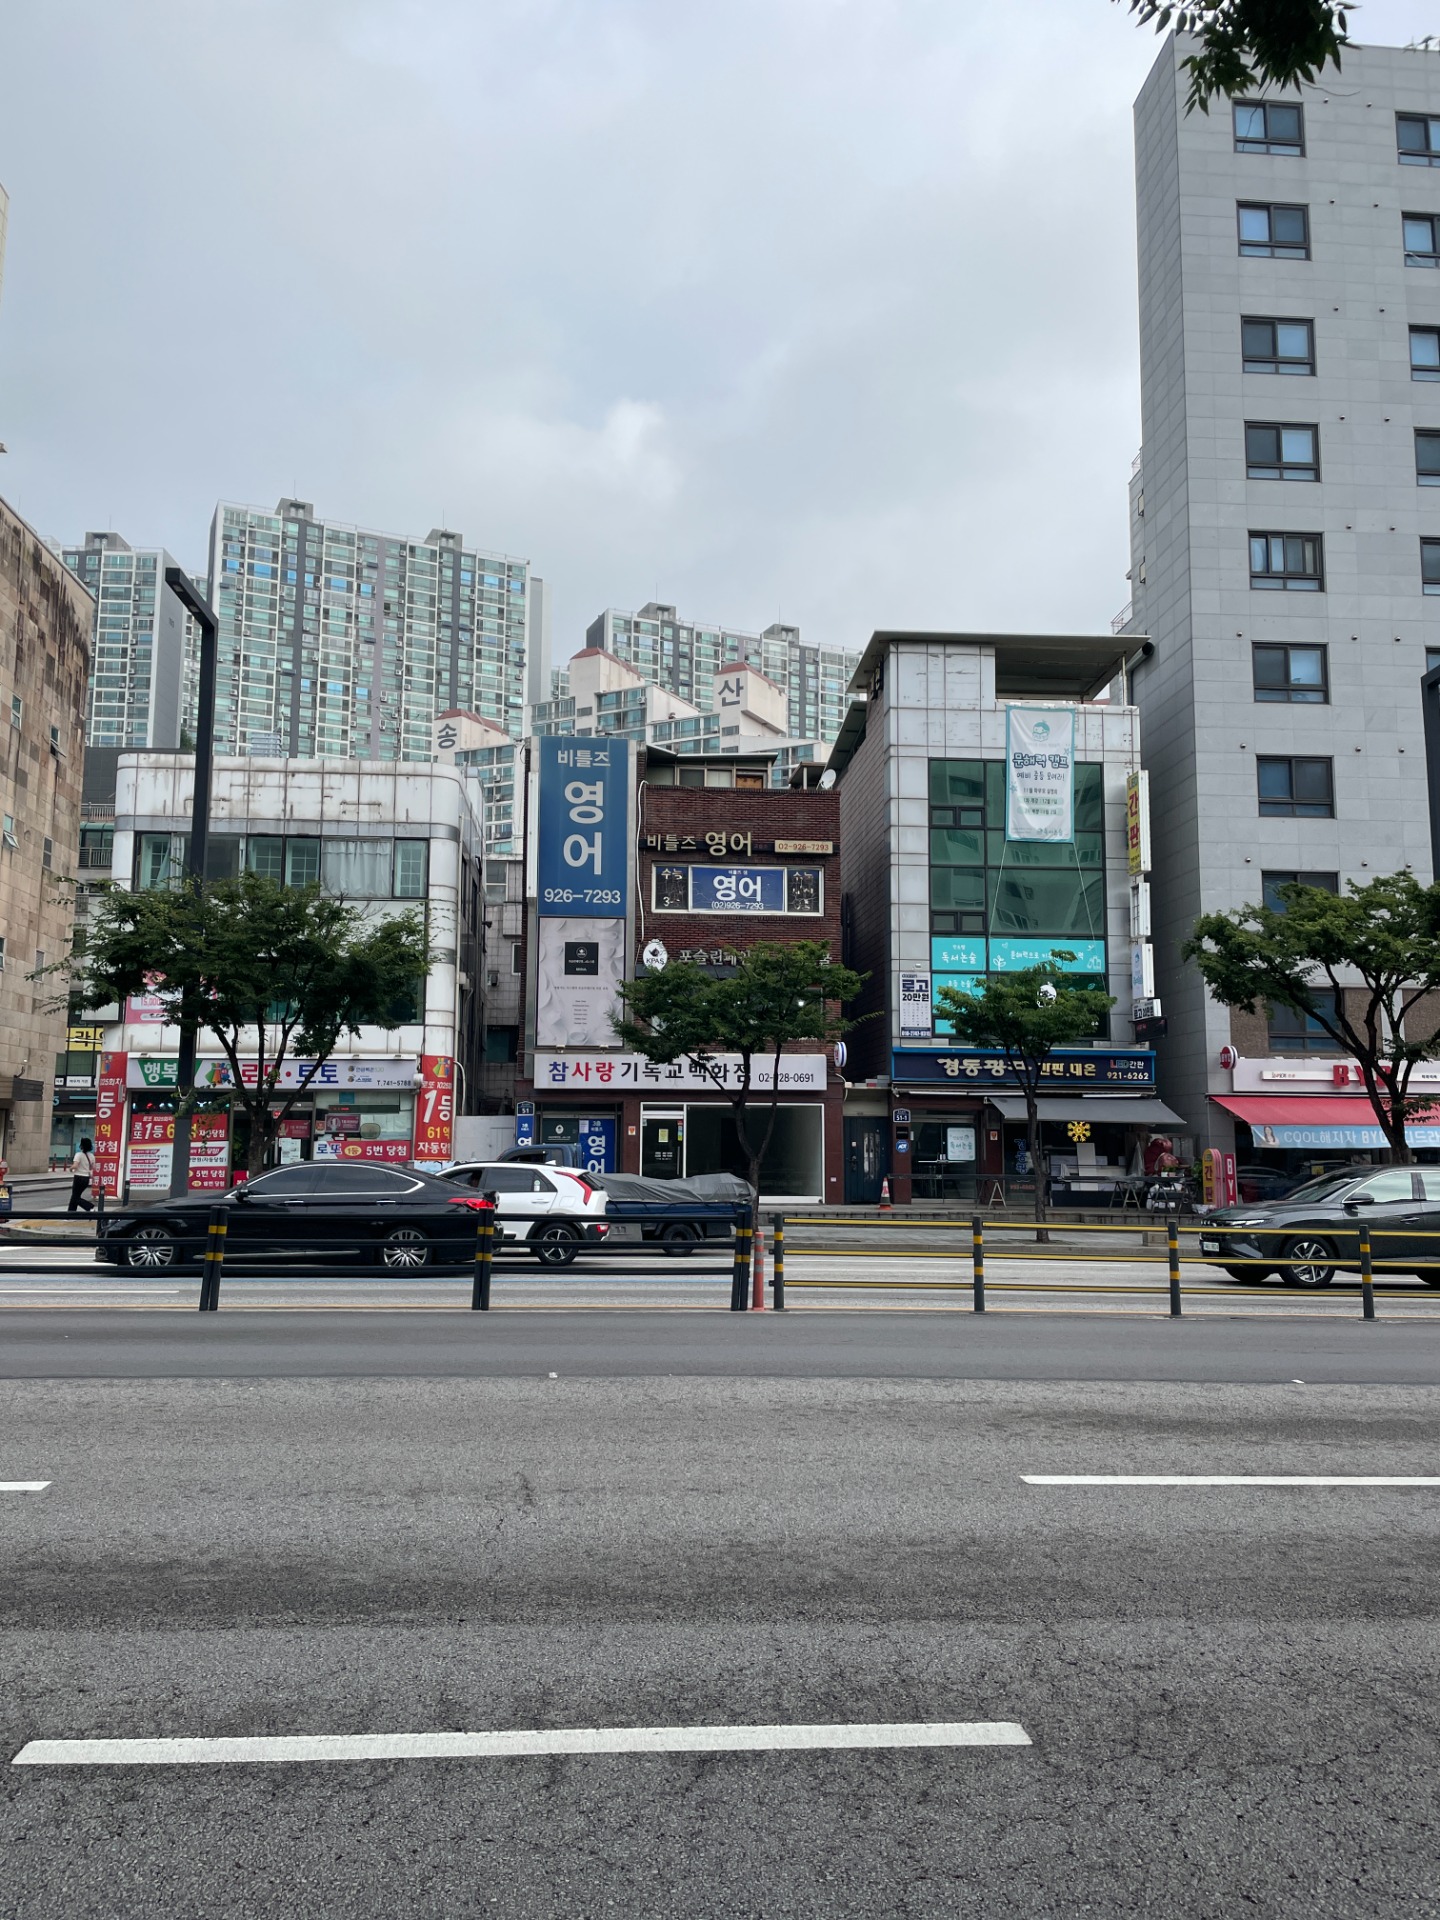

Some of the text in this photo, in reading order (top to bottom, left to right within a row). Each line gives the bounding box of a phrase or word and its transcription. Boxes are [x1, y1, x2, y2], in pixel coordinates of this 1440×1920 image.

[717, 677, 744, 707] 산
[436, 722, 458, 750] 송
[557, 749, 611, 768] 비틀즈
[1012, 752, 1069, 769] 문해력 캠프
[1129, 790, 1139, 849] 간판
[563, 781, 604, 875] 영어
[646, 831, 752, 857] 비틀즈 영어
[778, 841, 830, 852] 02-926-7293
[543, 888, 622, 904] 926-7293
[712, 875, 763, 902] 영어
[711, 900, 764, 911] (02)926-7293
[645, 957, 665, 966] KPAS
[941, 951, 977, 965] 독서논술
[902, 979, 929, 993] 로고
[902, 993, 930, 1002] 20만원
[758, 1072, 814, 1083] 02-28-0691
[1106, 1071, 1150, 1081] 921-6262
[316, 1143, 342, 1155] 로또
[366, 1146, 383, 1156] 5번
[386, 1145, 407, 1157] 당첨
